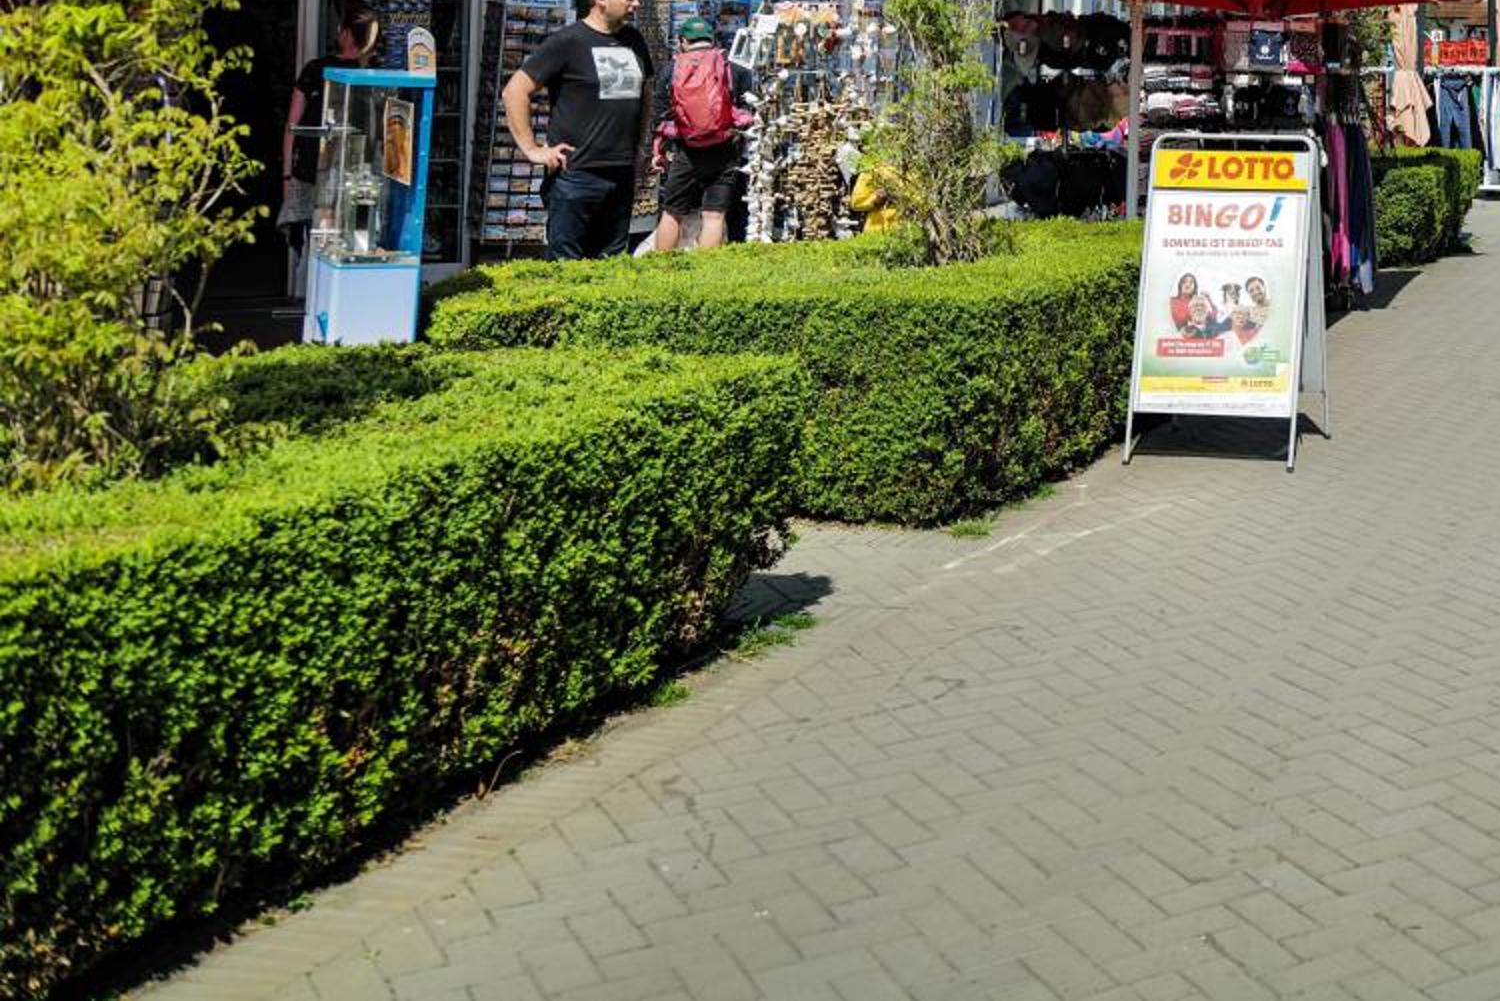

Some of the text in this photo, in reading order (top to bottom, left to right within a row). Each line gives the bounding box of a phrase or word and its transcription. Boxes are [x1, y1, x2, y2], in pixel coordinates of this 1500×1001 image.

[1207, 156, 1295, 180] LOTTO
[1167, 196, 1287, 233] BINGO!
[1162, 238, 1208, 248] SONNTAG
[1210, 239, 1225, 248] IST
